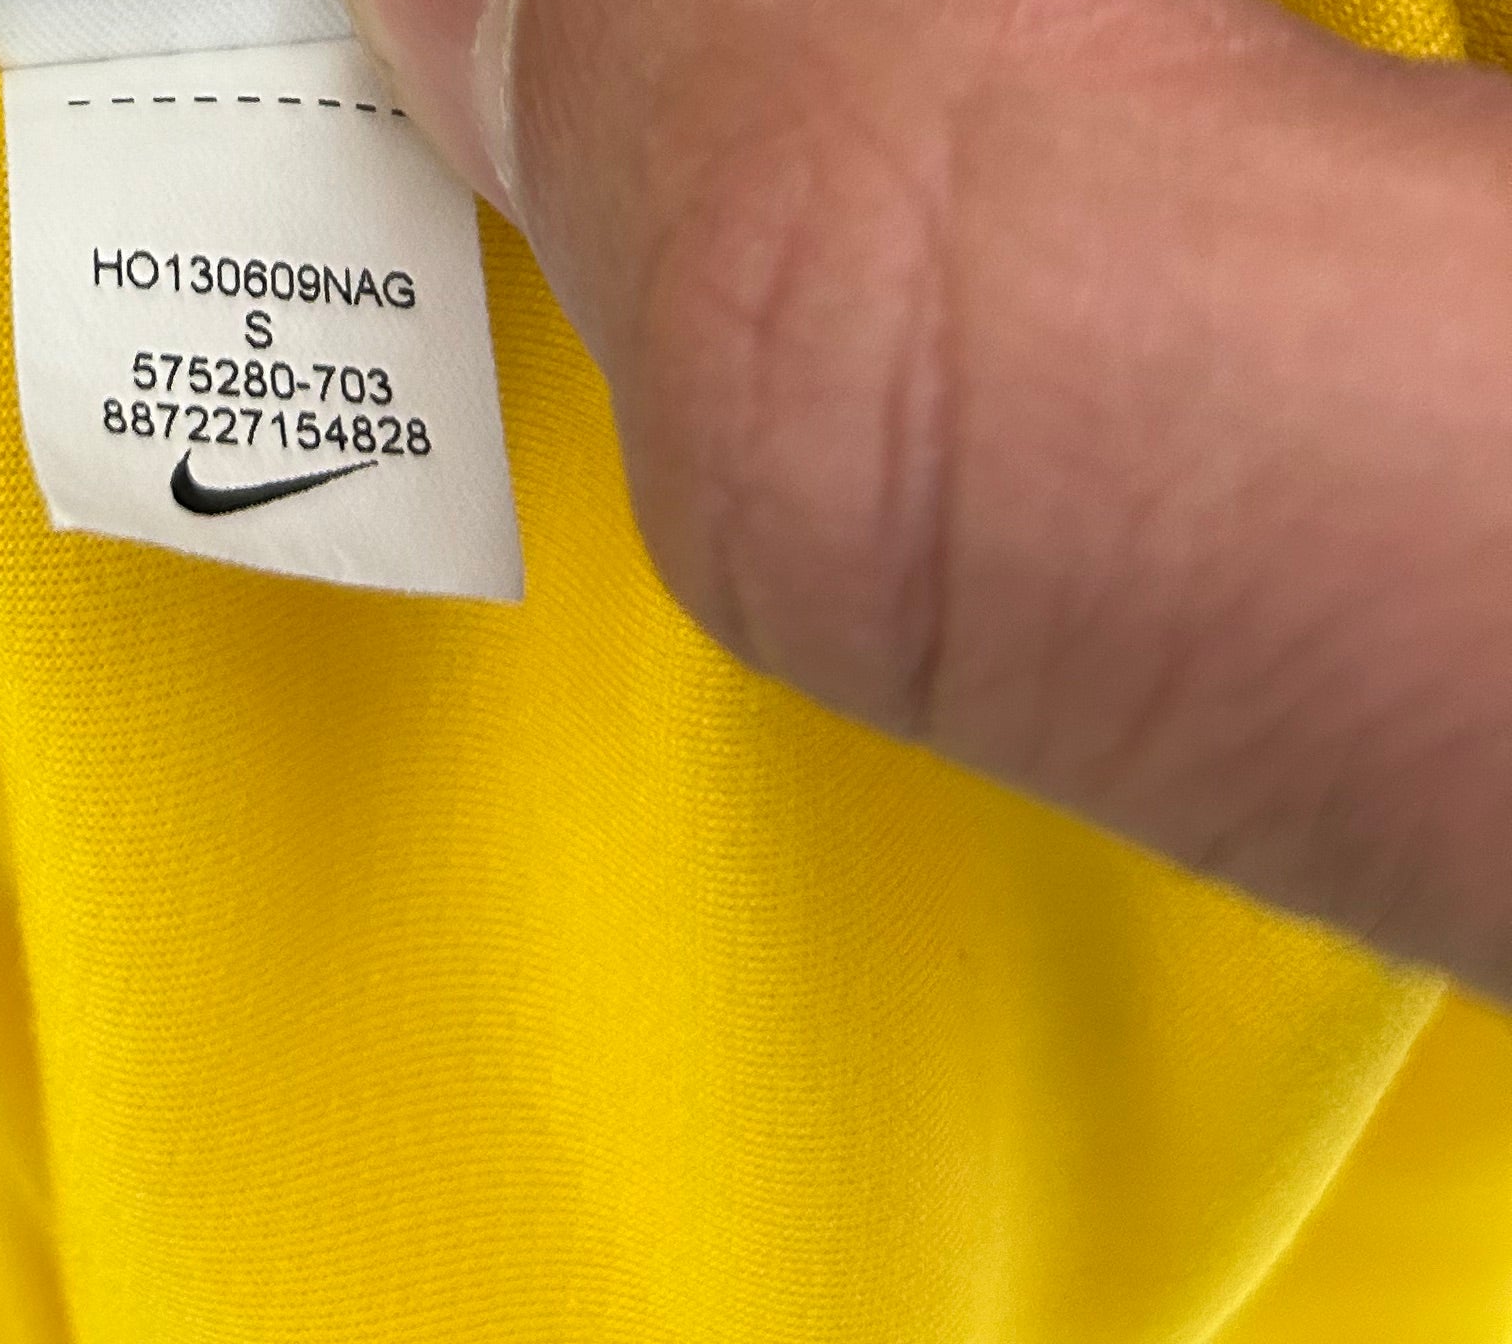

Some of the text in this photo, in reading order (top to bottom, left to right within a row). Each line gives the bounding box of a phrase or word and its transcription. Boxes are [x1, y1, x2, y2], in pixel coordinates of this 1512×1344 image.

[92, 246, 417, 311] HO130609NAG
[244, 309, 274, 351] S
[132, 351, 394, 408] 575280-703
[103, 397, 433, 458] 887227154828
